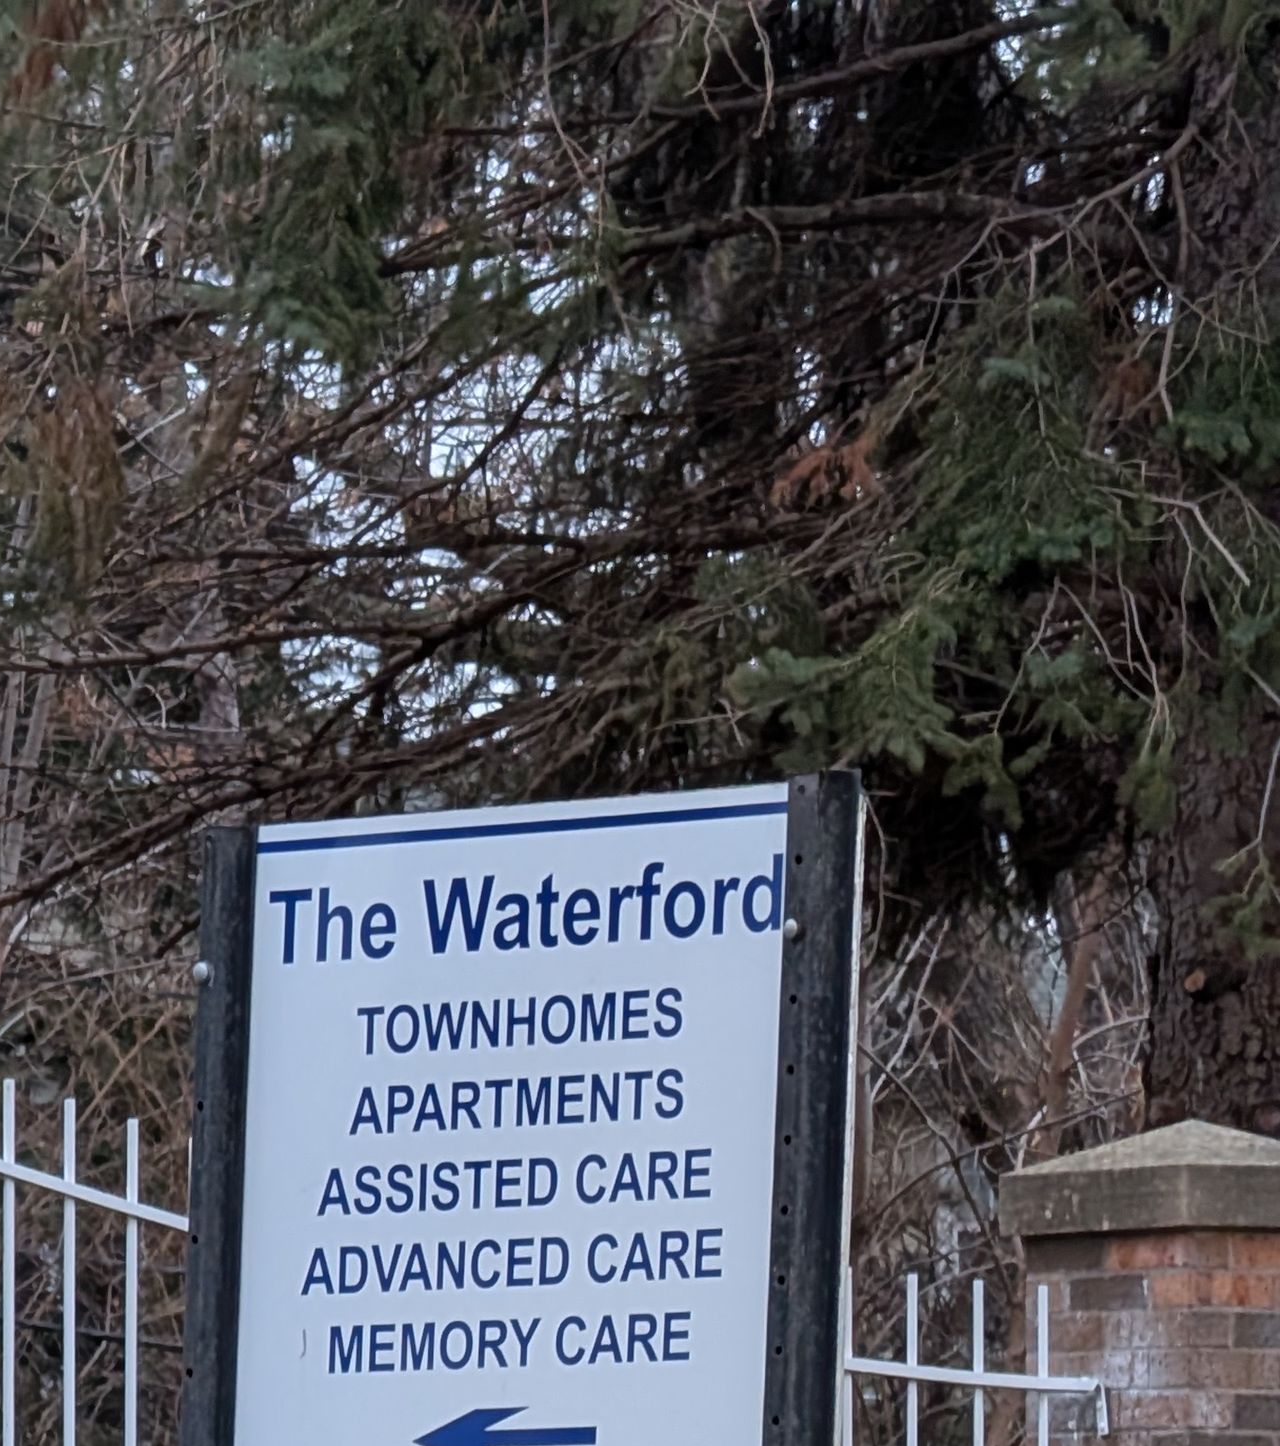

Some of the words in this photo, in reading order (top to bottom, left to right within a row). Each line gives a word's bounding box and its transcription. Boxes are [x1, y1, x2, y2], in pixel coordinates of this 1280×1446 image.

[269, 886, 397, 965] The
[422, 852, 785, 956] Waterford
[356, 987, 683, 1056] TOWNHOMES
[349, 1068, 684, 1136] APARTMENTS
[317, 1157, 559, 1217] ASSISTED
[575, 1147, 712, 1205] CARE
[300, 1236, 570, 1296] ADVANCED
[587, 1227, 723, 1284] CARE
[328, 1317, 542, 1375] MEMORY
[555, 1311, 692, 1366] CARE
